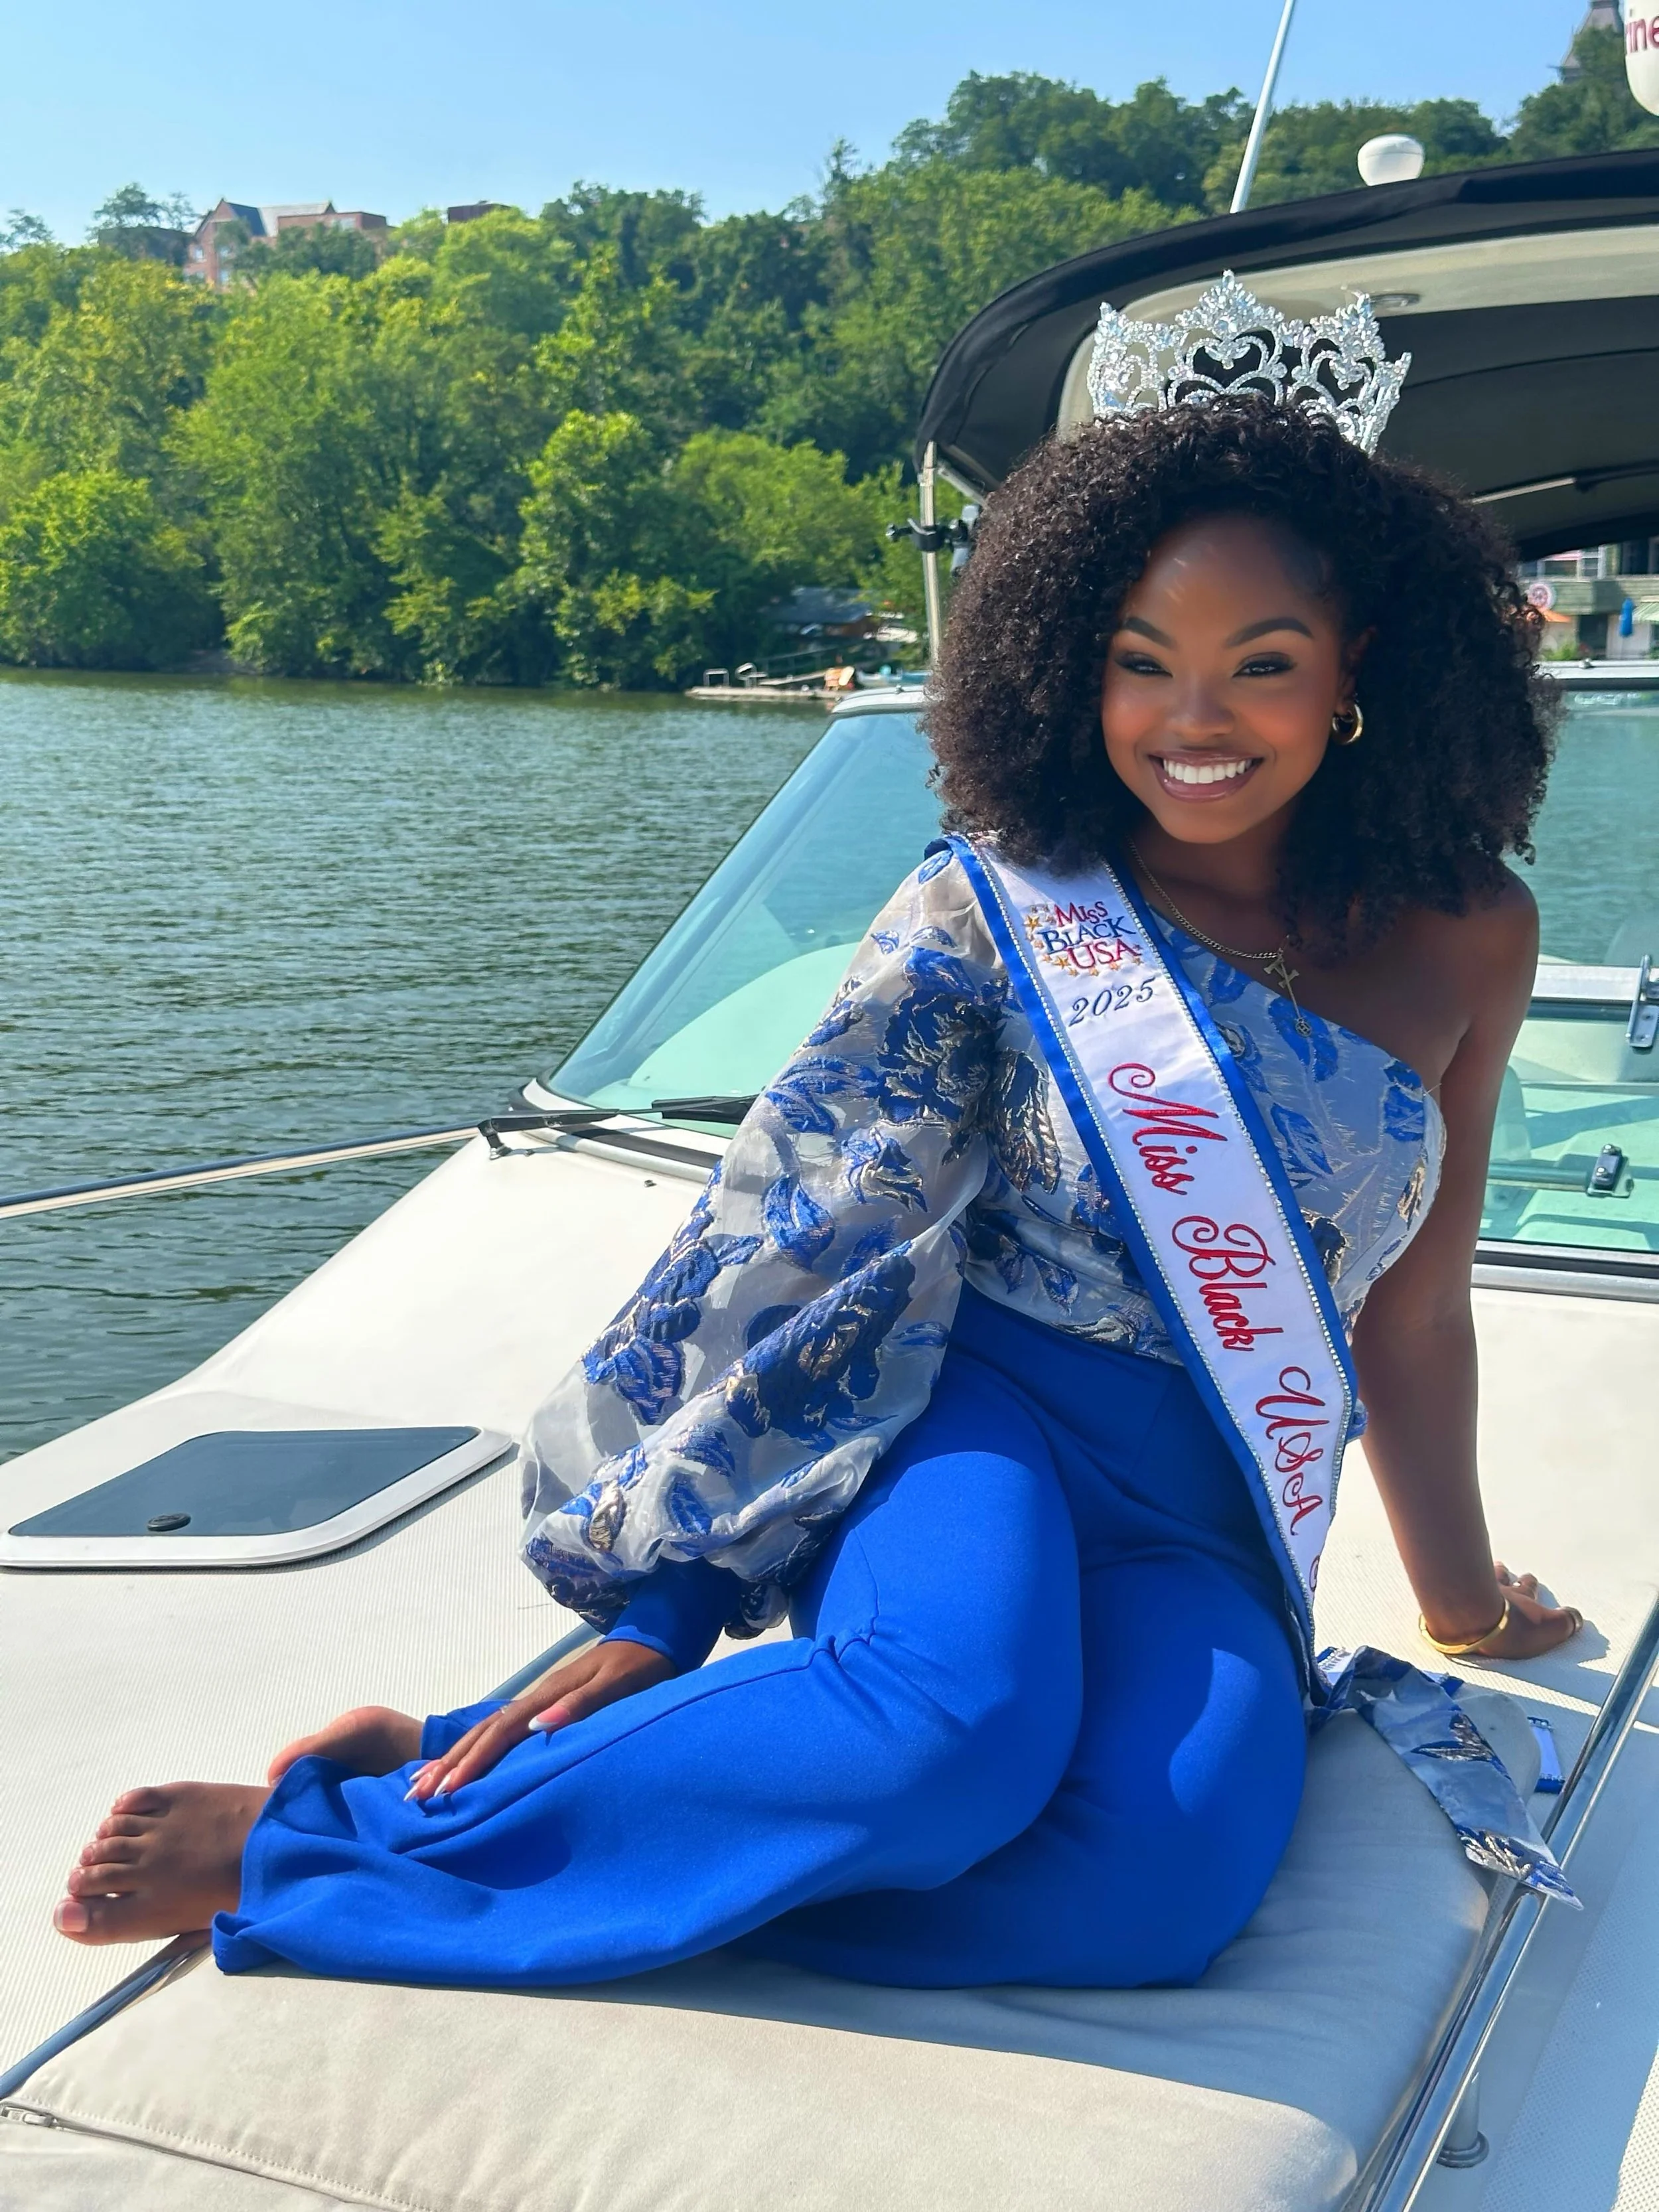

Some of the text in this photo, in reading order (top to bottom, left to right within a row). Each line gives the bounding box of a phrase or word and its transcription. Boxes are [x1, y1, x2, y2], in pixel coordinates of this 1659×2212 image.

[1037, 915, 1137, 955] BLACK
[1066, 938, 1143, 969] USA
[1068, 976, 1156, 1027] 2025
[1108, 1063, 1330, 1536] Miss Black USA
